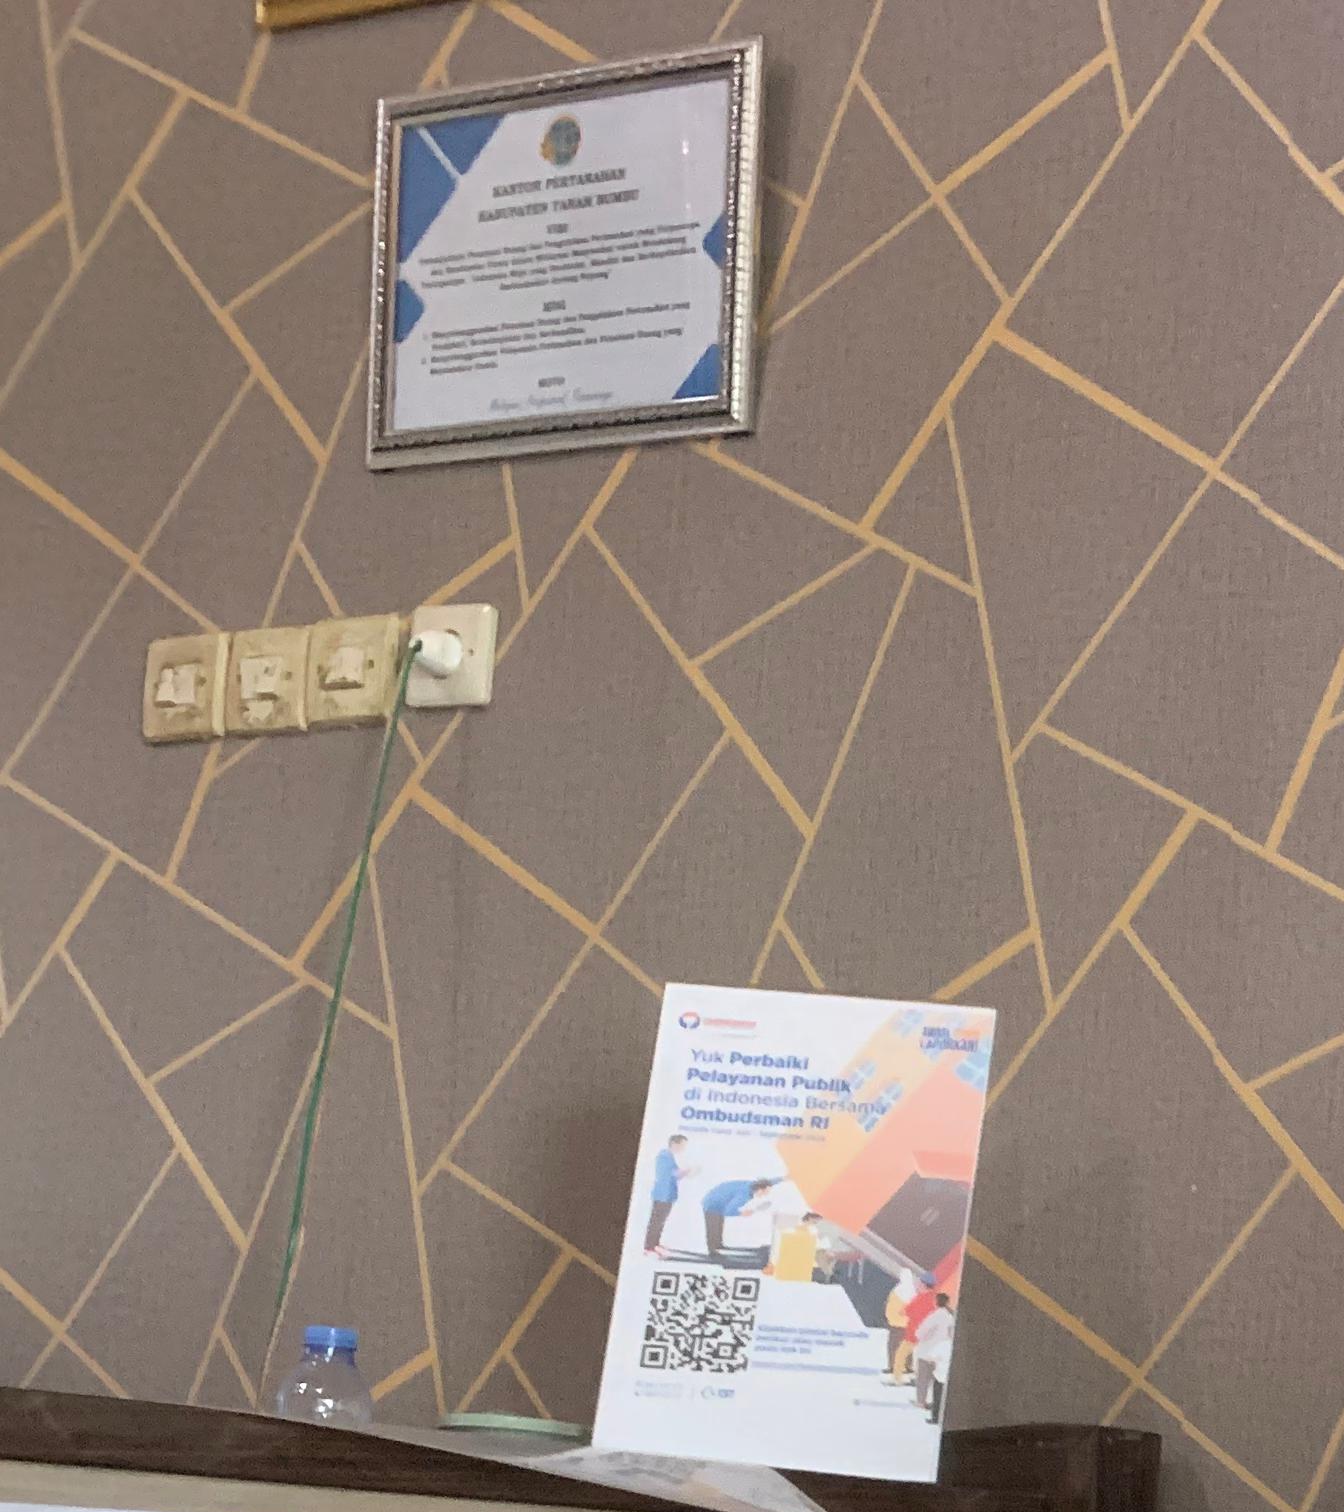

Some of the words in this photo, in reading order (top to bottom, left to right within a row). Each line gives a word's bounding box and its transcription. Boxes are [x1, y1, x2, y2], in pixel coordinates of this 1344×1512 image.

[690, 1049, 724, 1064] Yuk
[729, 1051, 810, 1070] Perbaiki
[687, 1068, 786, 1088] Pelayanan
[792, 1075, 851, 1093] Publik
[684, 1087, 703, 1101] di
[708, 1089, 799, 1109] Indonesia
[681, 1105, 805, 1128] Ombudsman
[810, 1116, 830, 1130] RI
